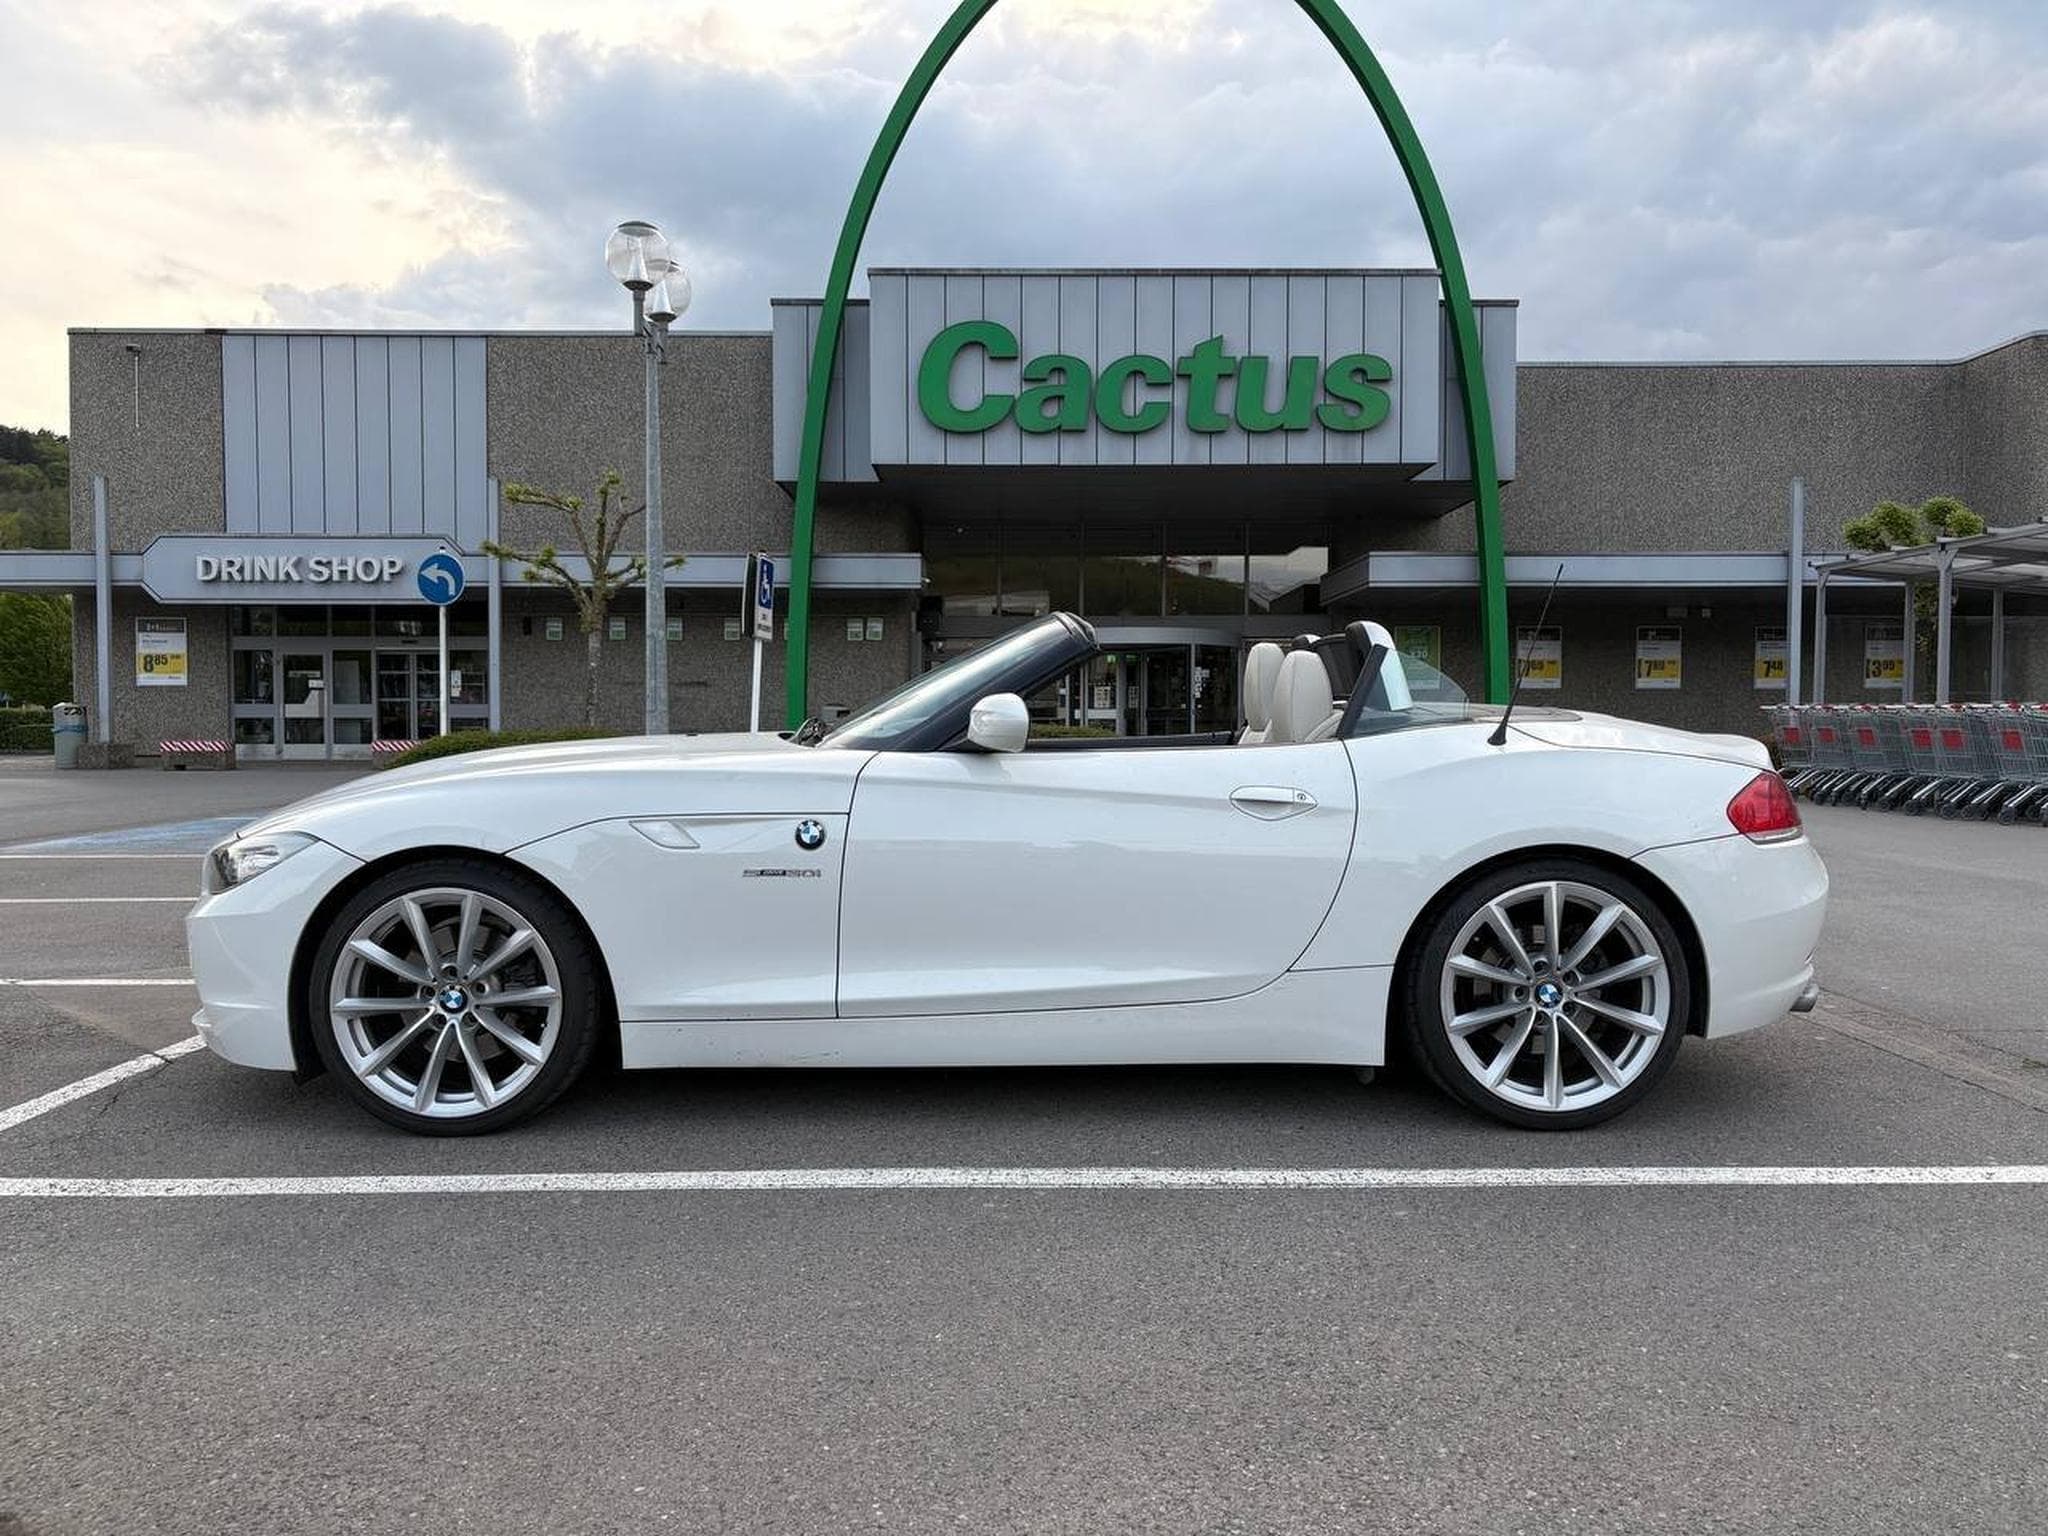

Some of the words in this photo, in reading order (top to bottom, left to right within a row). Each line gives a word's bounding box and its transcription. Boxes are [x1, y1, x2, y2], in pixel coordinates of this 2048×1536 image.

[918, 320, 1393, 433] Cactus
[195, 555, 304, 583] DRINK
[307, 555, 405, 583] SHOP
